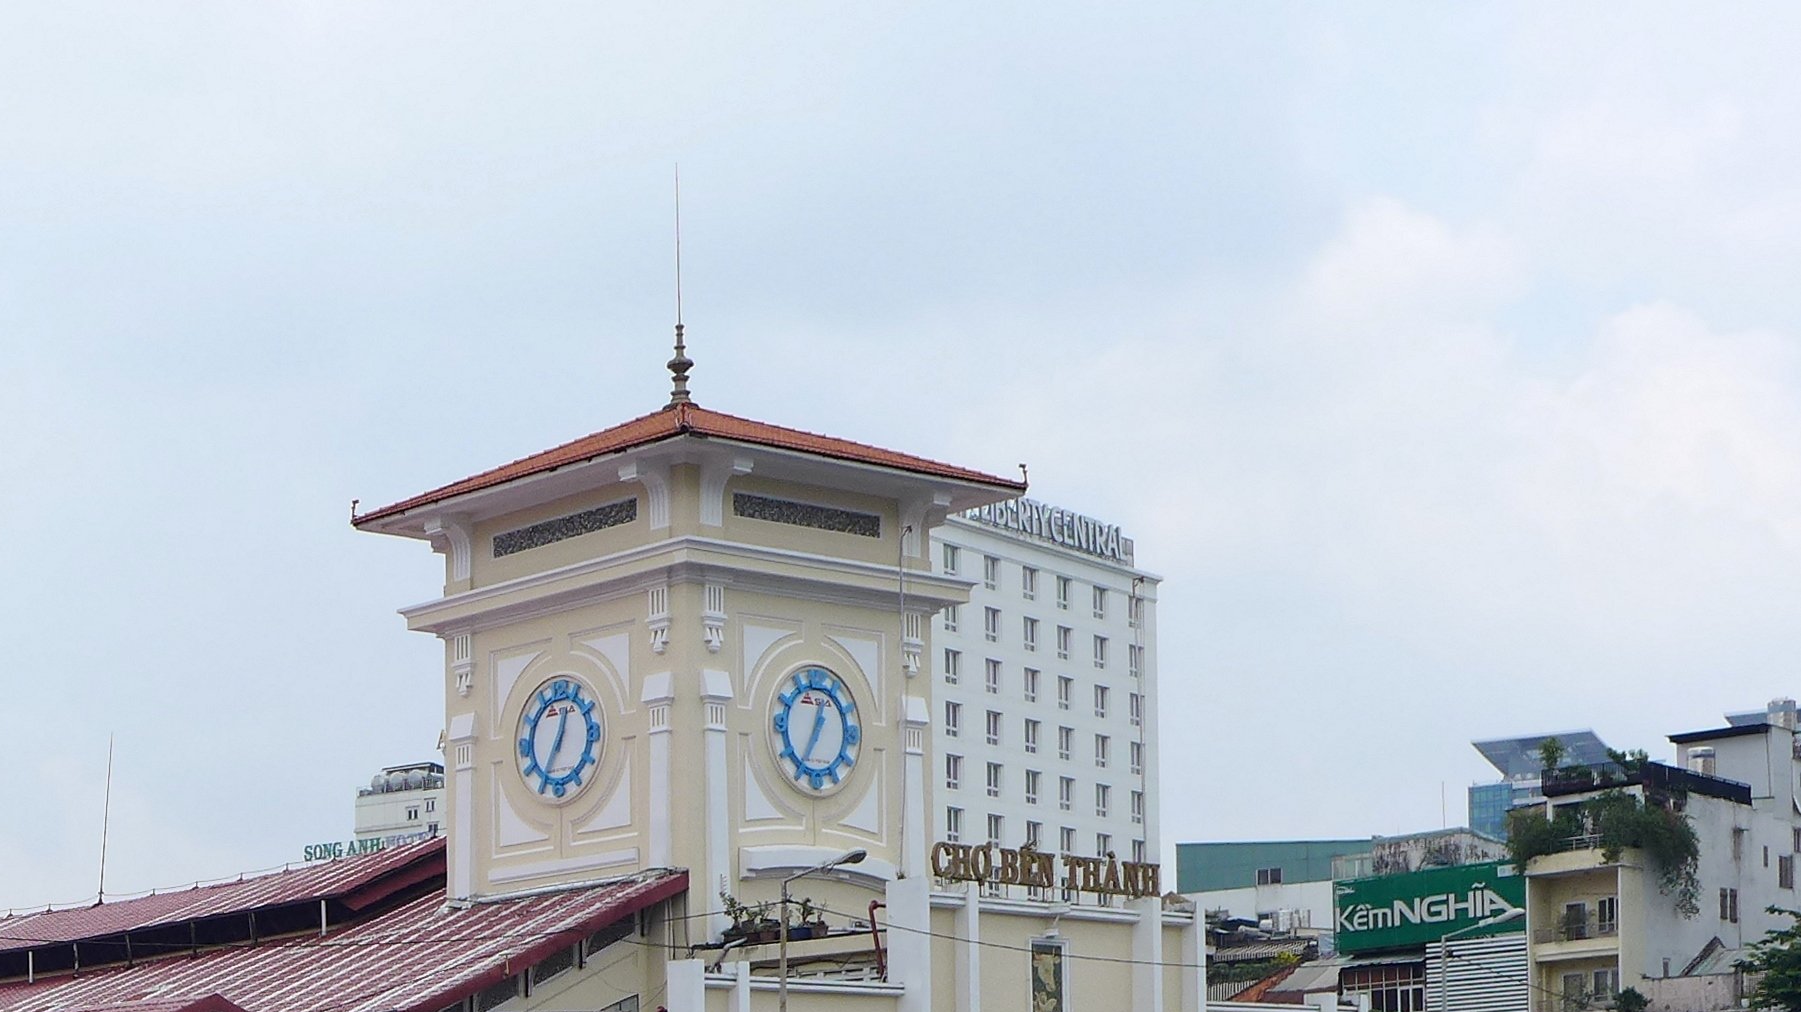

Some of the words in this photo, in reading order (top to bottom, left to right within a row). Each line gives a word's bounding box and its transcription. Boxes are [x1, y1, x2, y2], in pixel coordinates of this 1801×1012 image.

[303, 843, 343, 862] SONG
[346, 837, 382, 857] ANH
[931, 841, 993, 881] CHỢ
[1061, 850, 1161, 897] THÀNH
